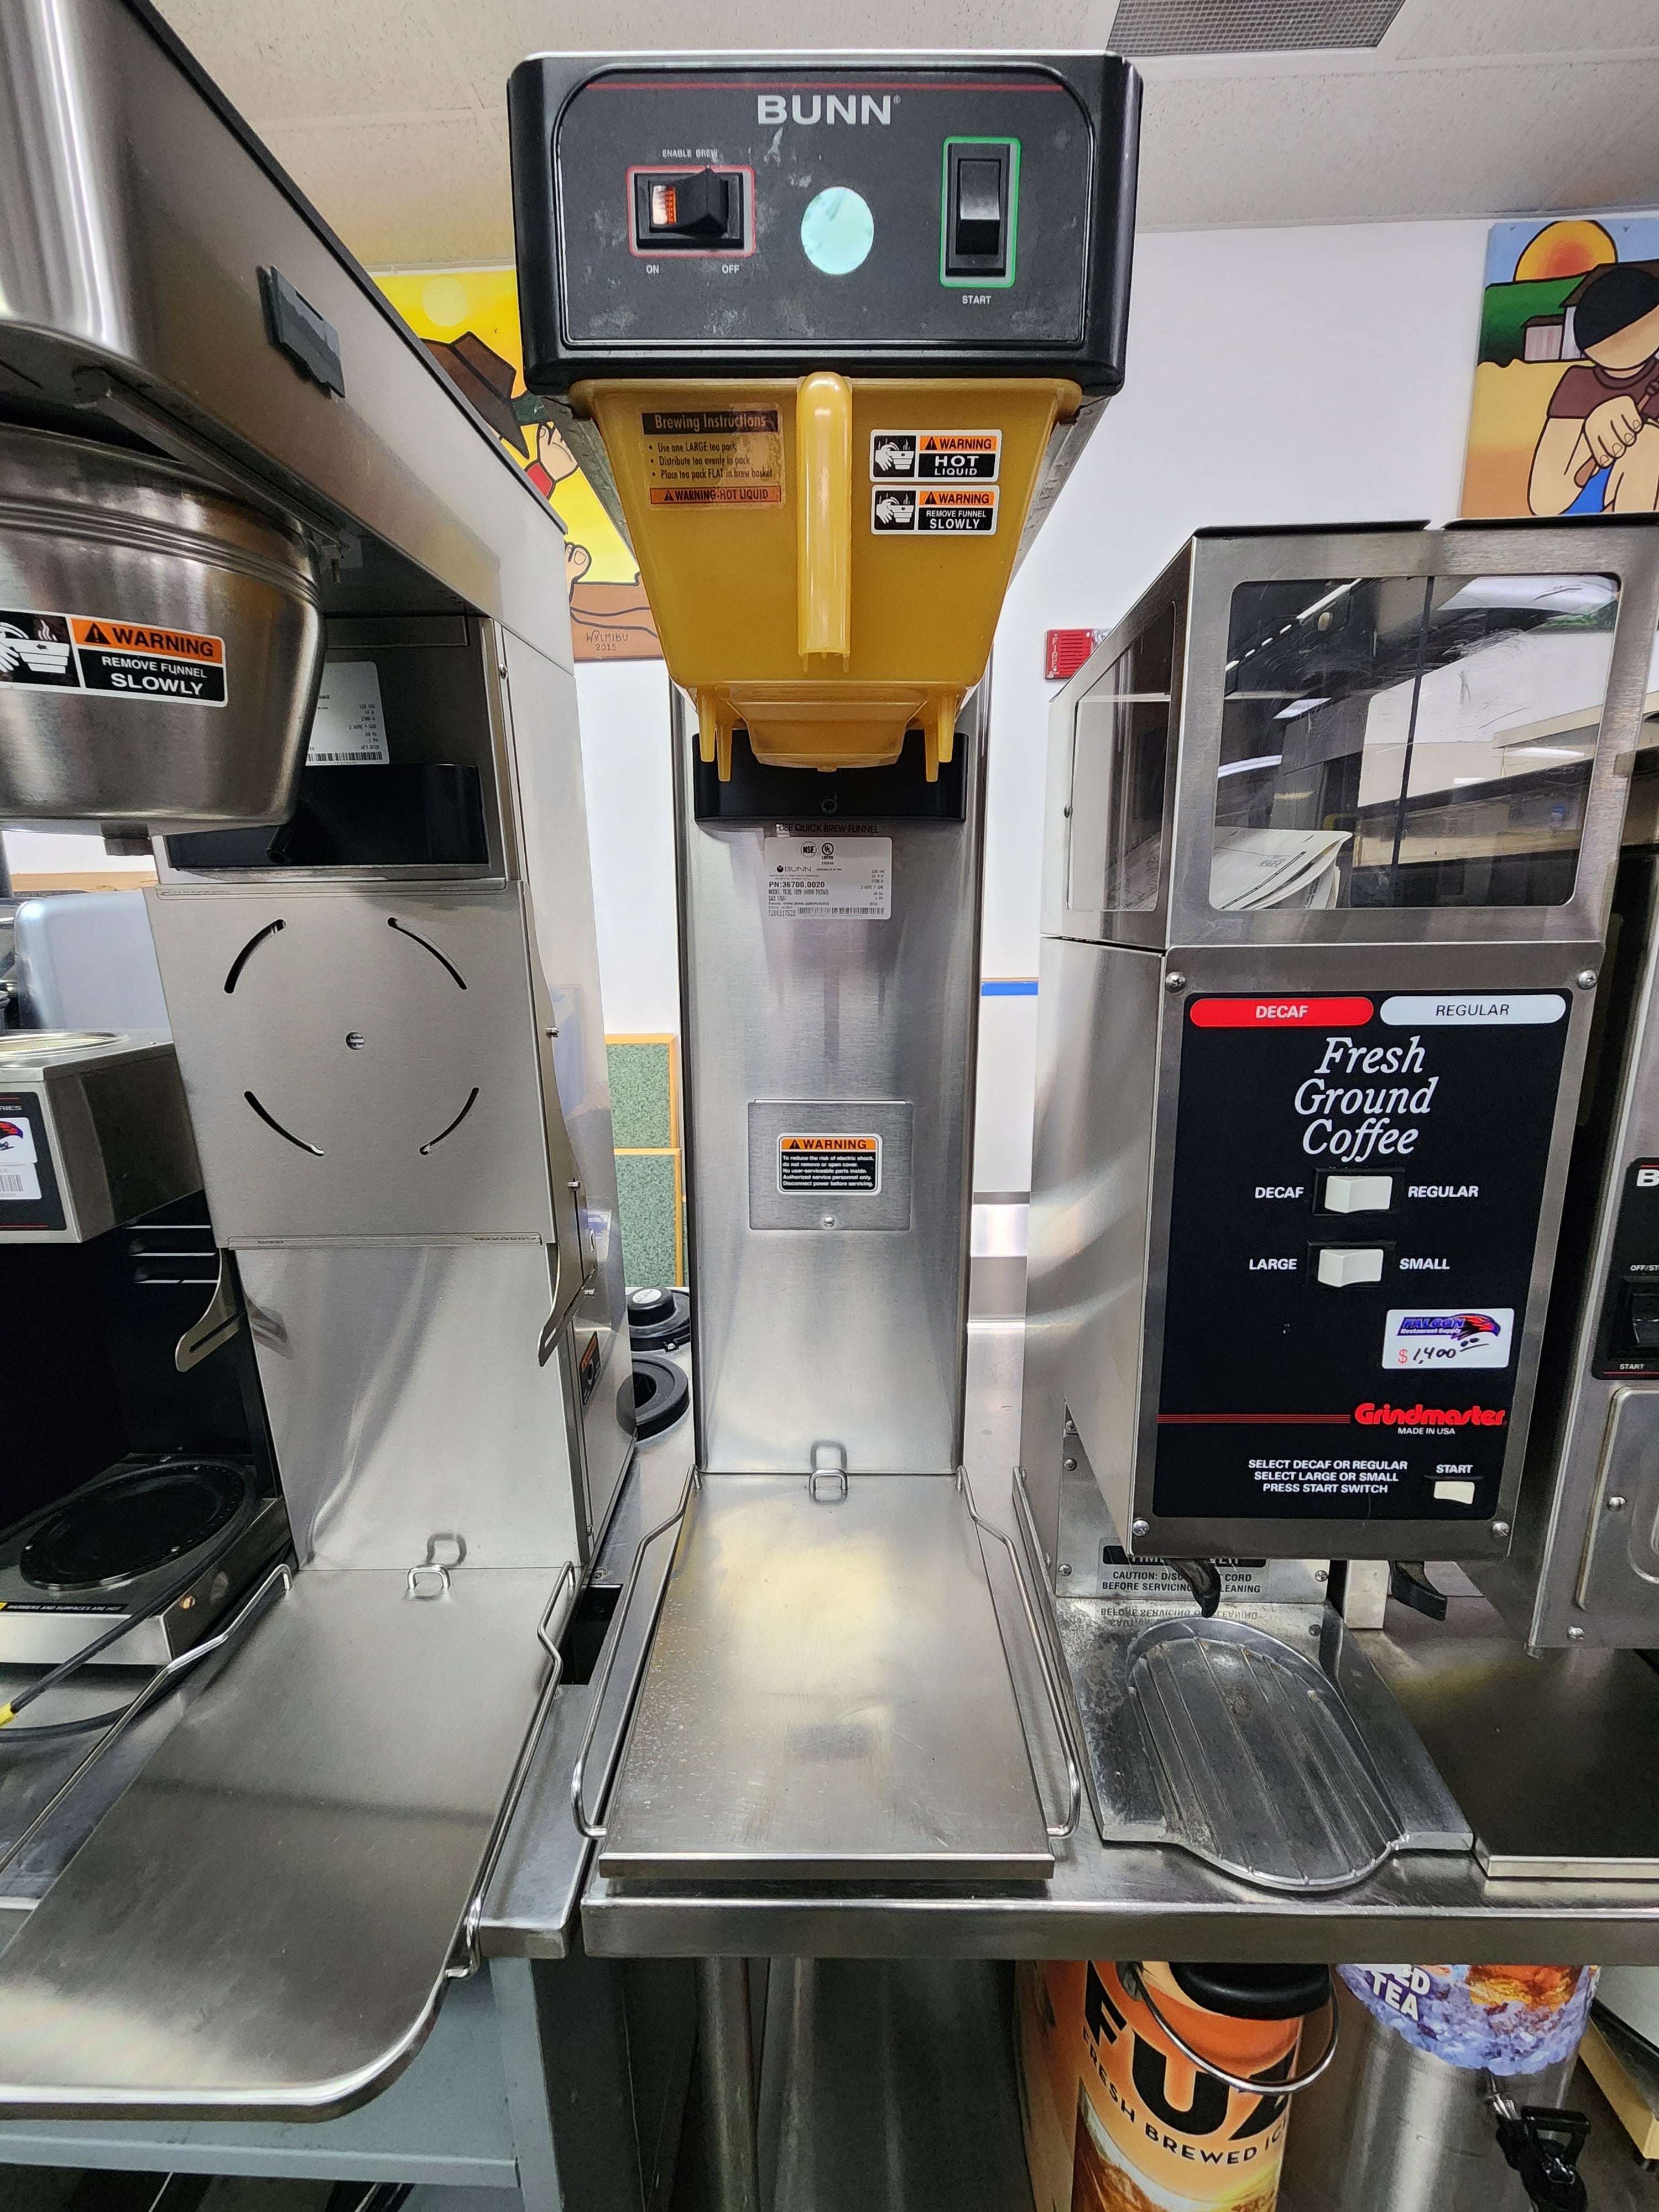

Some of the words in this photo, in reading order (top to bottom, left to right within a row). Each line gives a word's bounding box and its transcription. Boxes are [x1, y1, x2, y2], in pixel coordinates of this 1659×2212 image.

[758, 95, 891, 125] BUNN
[662, 149, 692, 158] ENABLE
[696, 149, 718, 158] BREW
[646, 264, 659, 274] ON
[722, 265, 739, 274] OFF
[962, 295, 992, 304] START
[655, 415, 700, 431] Brewing
[703, 413, 766, 429] Instructions
[658, 442, 670, 452] Use
[685, 441, 708, 451] LARGE
[709, 443, 719, 451] tea
[722, 441, 737, 453] pack
[940, 439, 992, 450] WARNING
[659, 455, 690, 465] Distribute
[692, 456, 703, 465] tea
[705, 454, 725, 467] evenly
[727, 456, 733, 465] in
[935, 456, 979, 467] HOT
[661, 469, 677, 479] Place
[679, 470, 689, 479] tea
[691, 468, 706, 481] pack
[708, 468, 723, 478] FLAT
[726, 469, 732, 478] in
[734, 467, 749, 478] brew
[752, 467, 773, 478] basket
[740, 488, 768, 500] LIQUID
[938, 493, 989, 504] WARNING
[930, 518, 980, 529] SLOWLY
[111, 627, 213, 657] WARNING
[102, 656, 158, 671] REMOVE
[161, 662, 207, 678] FUNNEL
[111, 673, 203, 695] SLOWLY
[795, 823, 822, 832] QUICK
[848, 825, 879, 833] FUNNEL
[1256, 1004, 1308, 1019] DECAF
[1436, 1004, 1510, 1017] REGULAR
[1314, 1035, 1426, 1074] Fresh
[1295, 1076, 1439, 1115] Ground
[802, 1139, 867, 1149] WARNING
[1302, 1117, 1419, 1162] Coffee
[1255, 1186, 1304, 1198] DECAF
[1408, 1185, 1479, 1198] REGULAR
[1249, 1259, 1297, 1270] LARGE
[1399, 1258, 1450, 1270] SMALL
[1403, 1318, 1466, 1328] FALCON
[1355, 1403, 1505, 1426] Grindmaster
[1249, 1460, 1291, 1469] SELECT
[1293, 1460, 1332, 1469] DECAF
[1333, 1460, 1350, 1469] OR
[1352, 1460, 1408, 1470] REGULAR
[1436, 1464, 1473, 1474] START
[1254, 1472, 1296, 1480] SELECT
[1298, 1472, 1336, 1481] LARGE
[1340, 1472, 1357, 1481] OR
[1359, 1473, 1399, 1481] SMALL
[1263, 1483, 1300, 1492] PRESS
[1302, 1484, 1339, 1493] START
[1340, 1484, 1388, 1493] SWITCH
[1113, 1571, 1158, 1580] CAUTION:
[1225, 1573, 1251, 1582] CORD
[1103, 1582, 1139, 1590] BEFORE
[1370, 1970, 1419, 2022] TEA
[1083, 2026, 1135, 2124] FRESH
[1145, 2122, 1257, 2166] BREWED
